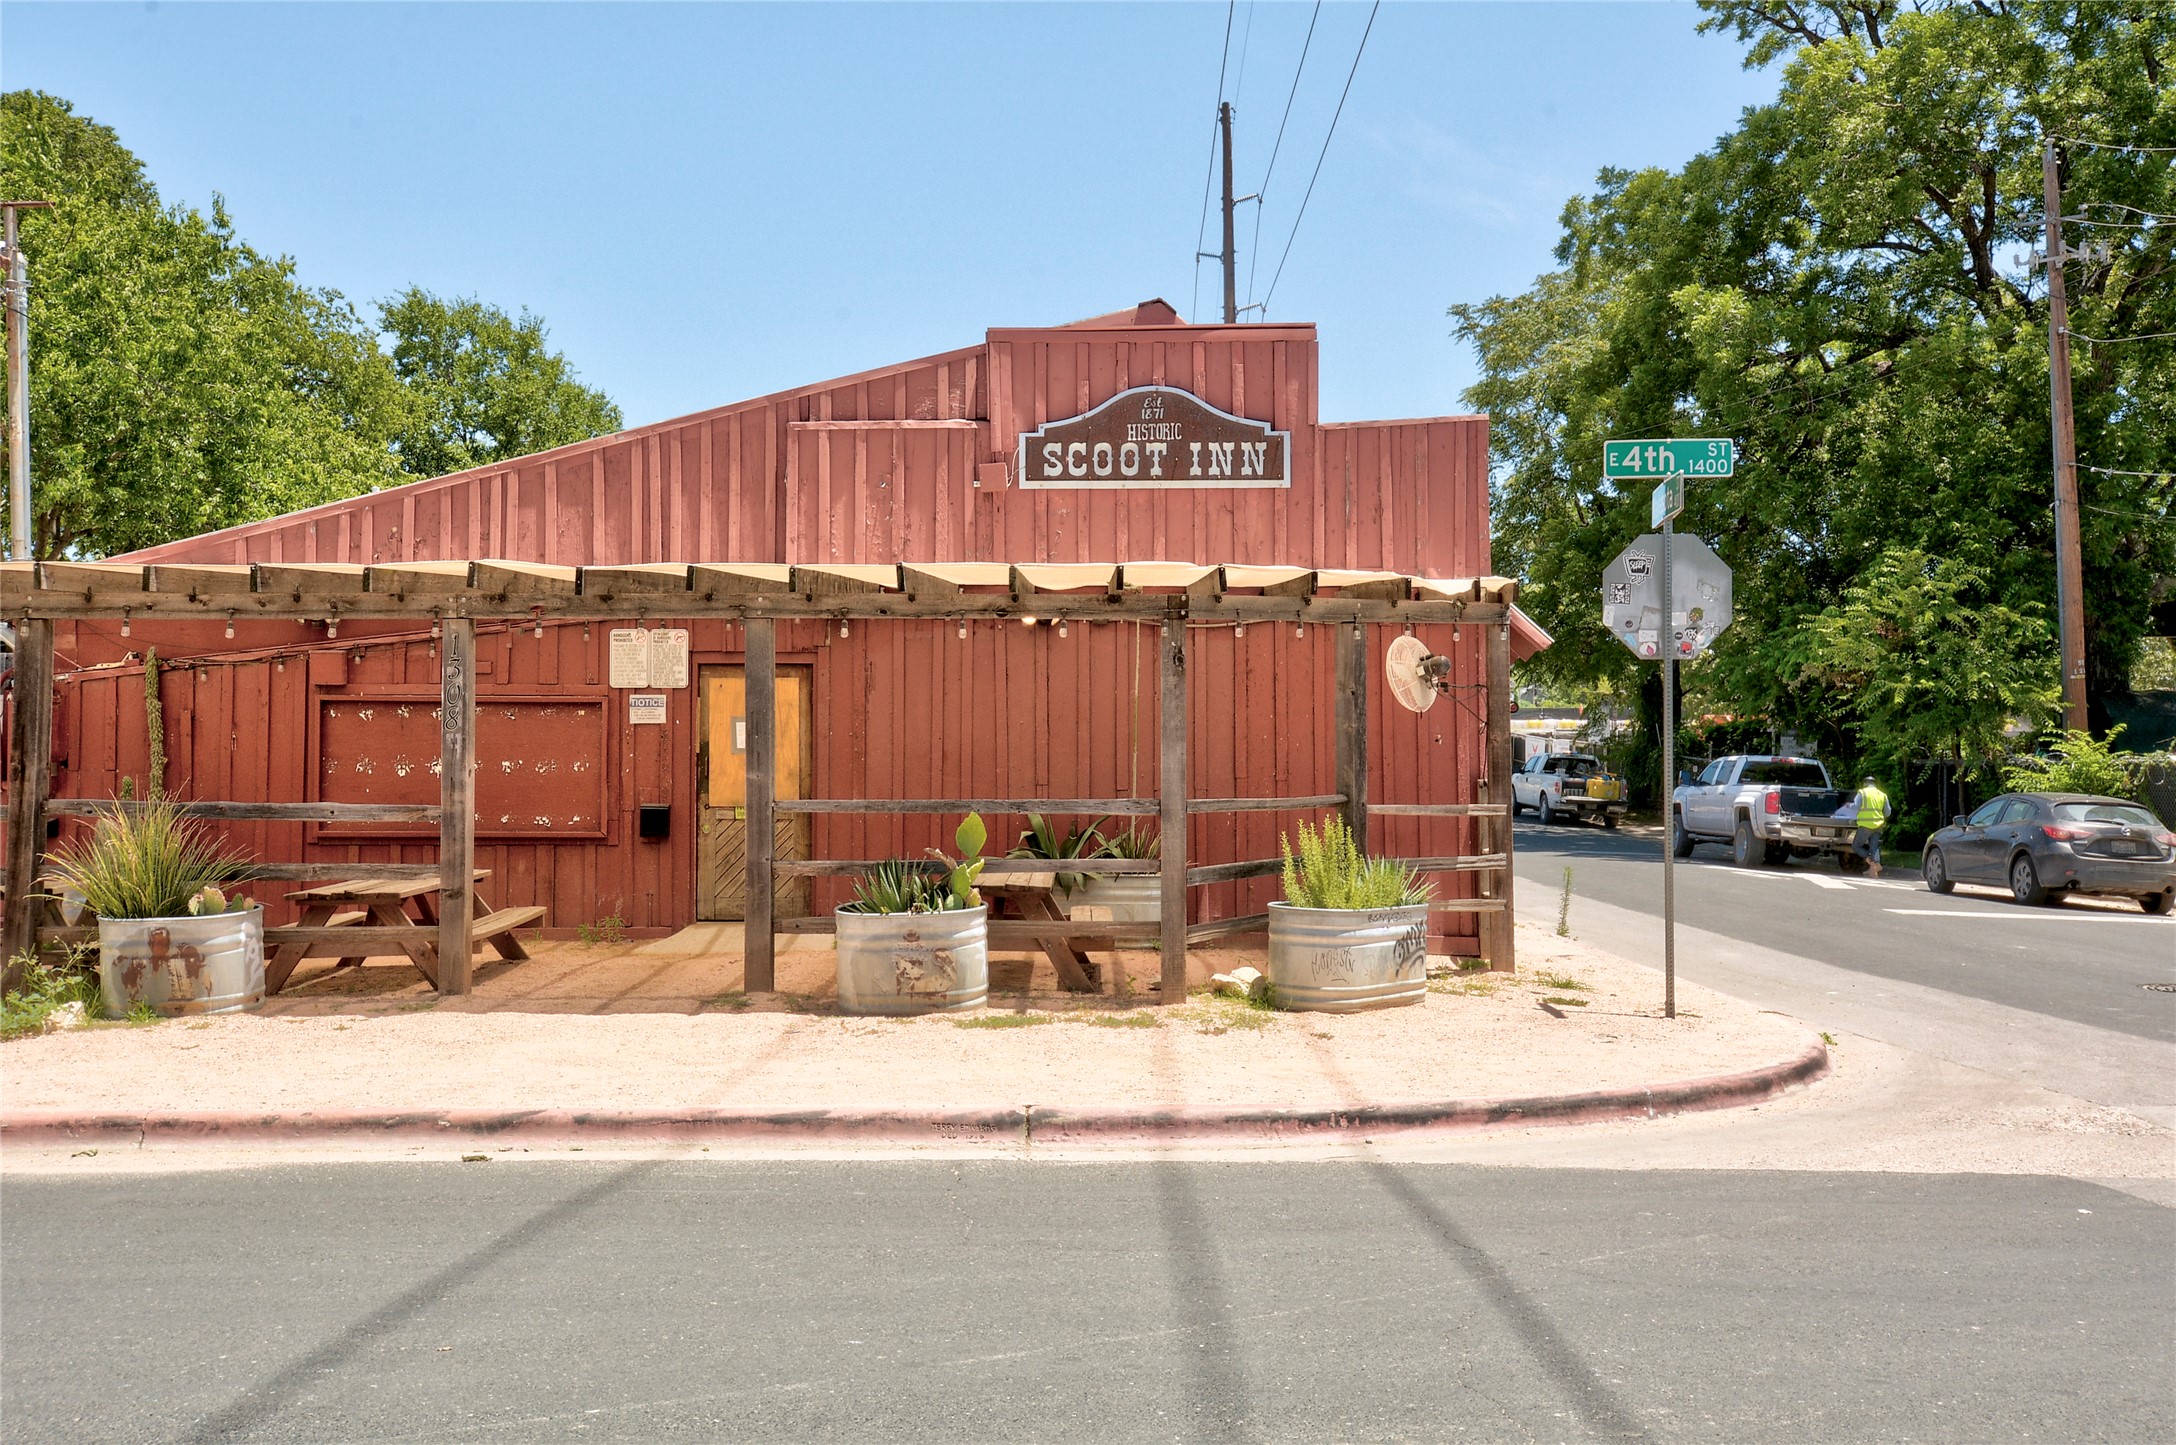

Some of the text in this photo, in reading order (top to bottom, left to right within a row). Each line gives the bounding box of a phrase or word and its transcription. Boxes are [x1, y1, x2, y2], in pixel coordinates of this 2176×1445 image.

[1143, 397, 1164, 408] Est.
[1141, 408, 1164, 420] 1871
[1127, 423, 1182, 442] HISTORIC
[1708, 442, 1728, 457] ST
[1042, 441, 1268, 477] SCOOT INN
[1609, 445, 1675, 472] E 4th
[1688, 459, 1728, 474] 1400
[444, 632, 462, 731] 1308
[631, 698, 665, 707] NOTICE
[931, 1122, 957, 1131] TERRY
